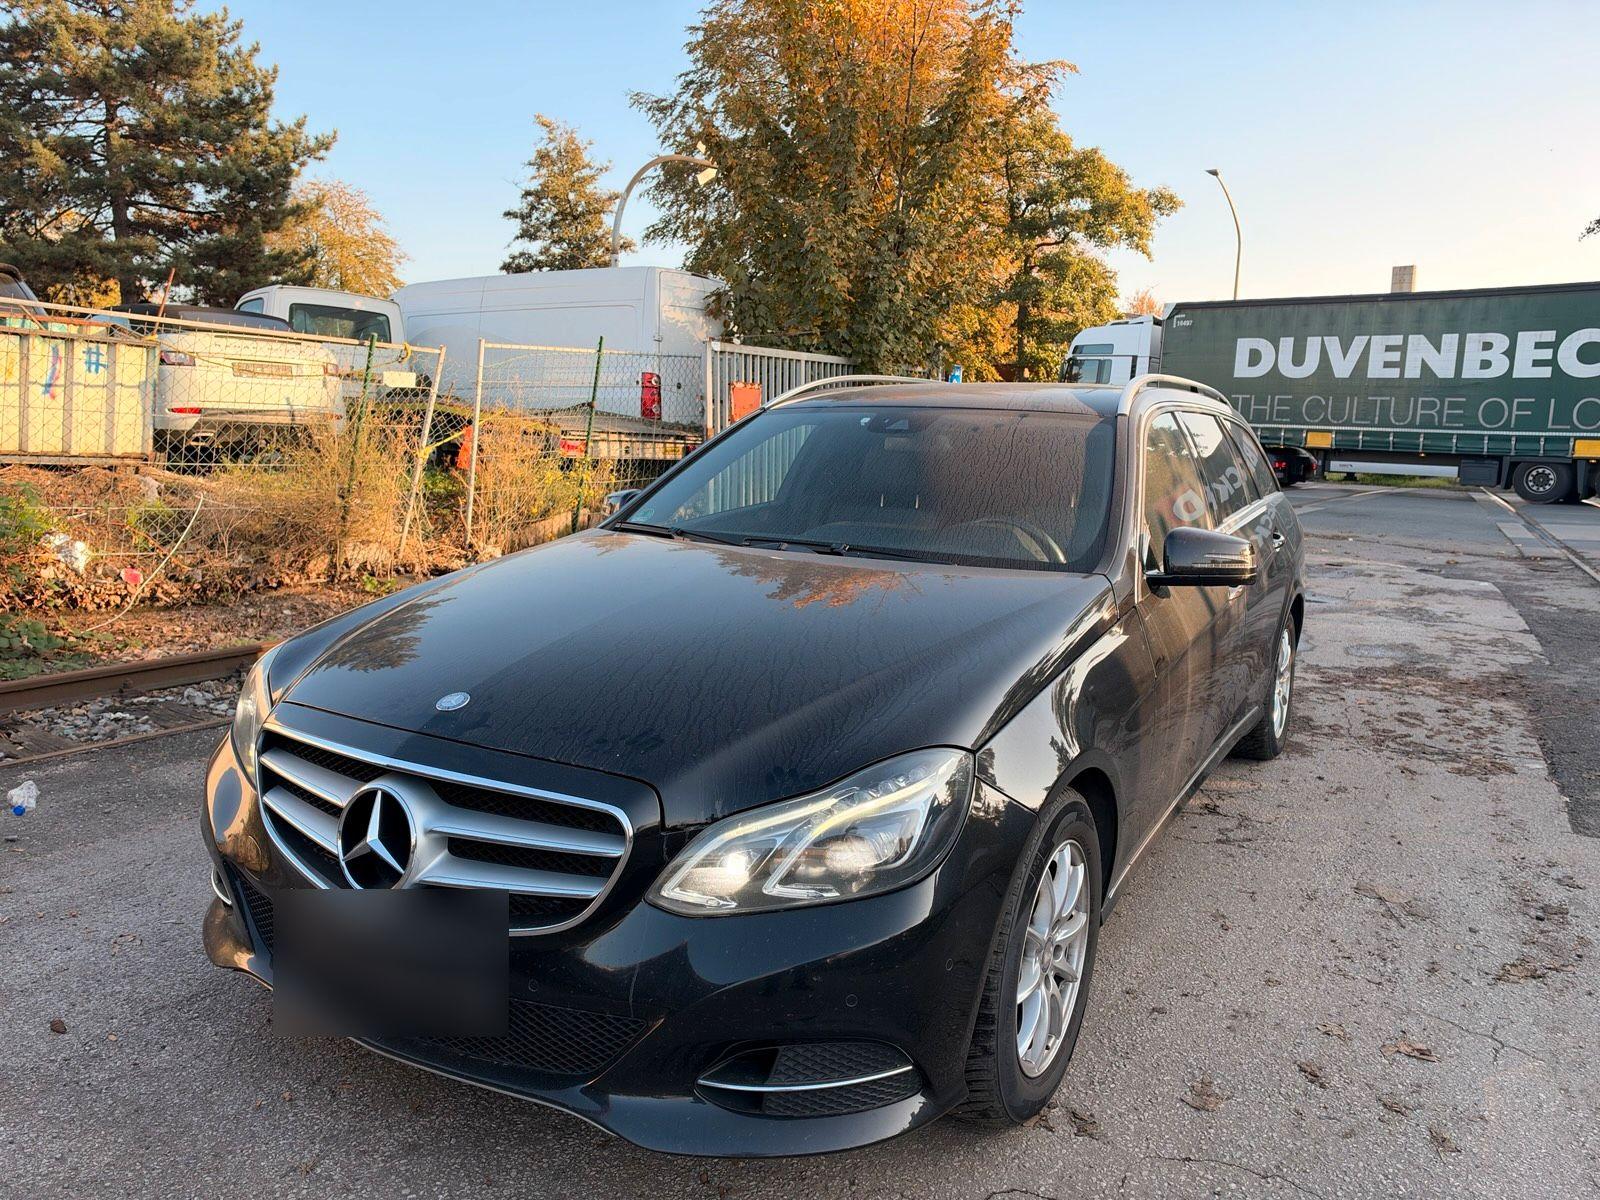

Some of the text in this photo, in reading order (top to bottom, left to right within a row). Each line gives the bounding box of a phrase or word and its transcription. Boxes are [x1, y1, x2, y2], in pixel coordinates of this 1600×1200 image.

[1233, 328, 1600, 379] DUVENBEC
[1231, 394, 1293, 422] THE
[1302, 395, 1467, 427] CULTURE
[1477, 397, 1536, 429] OF
